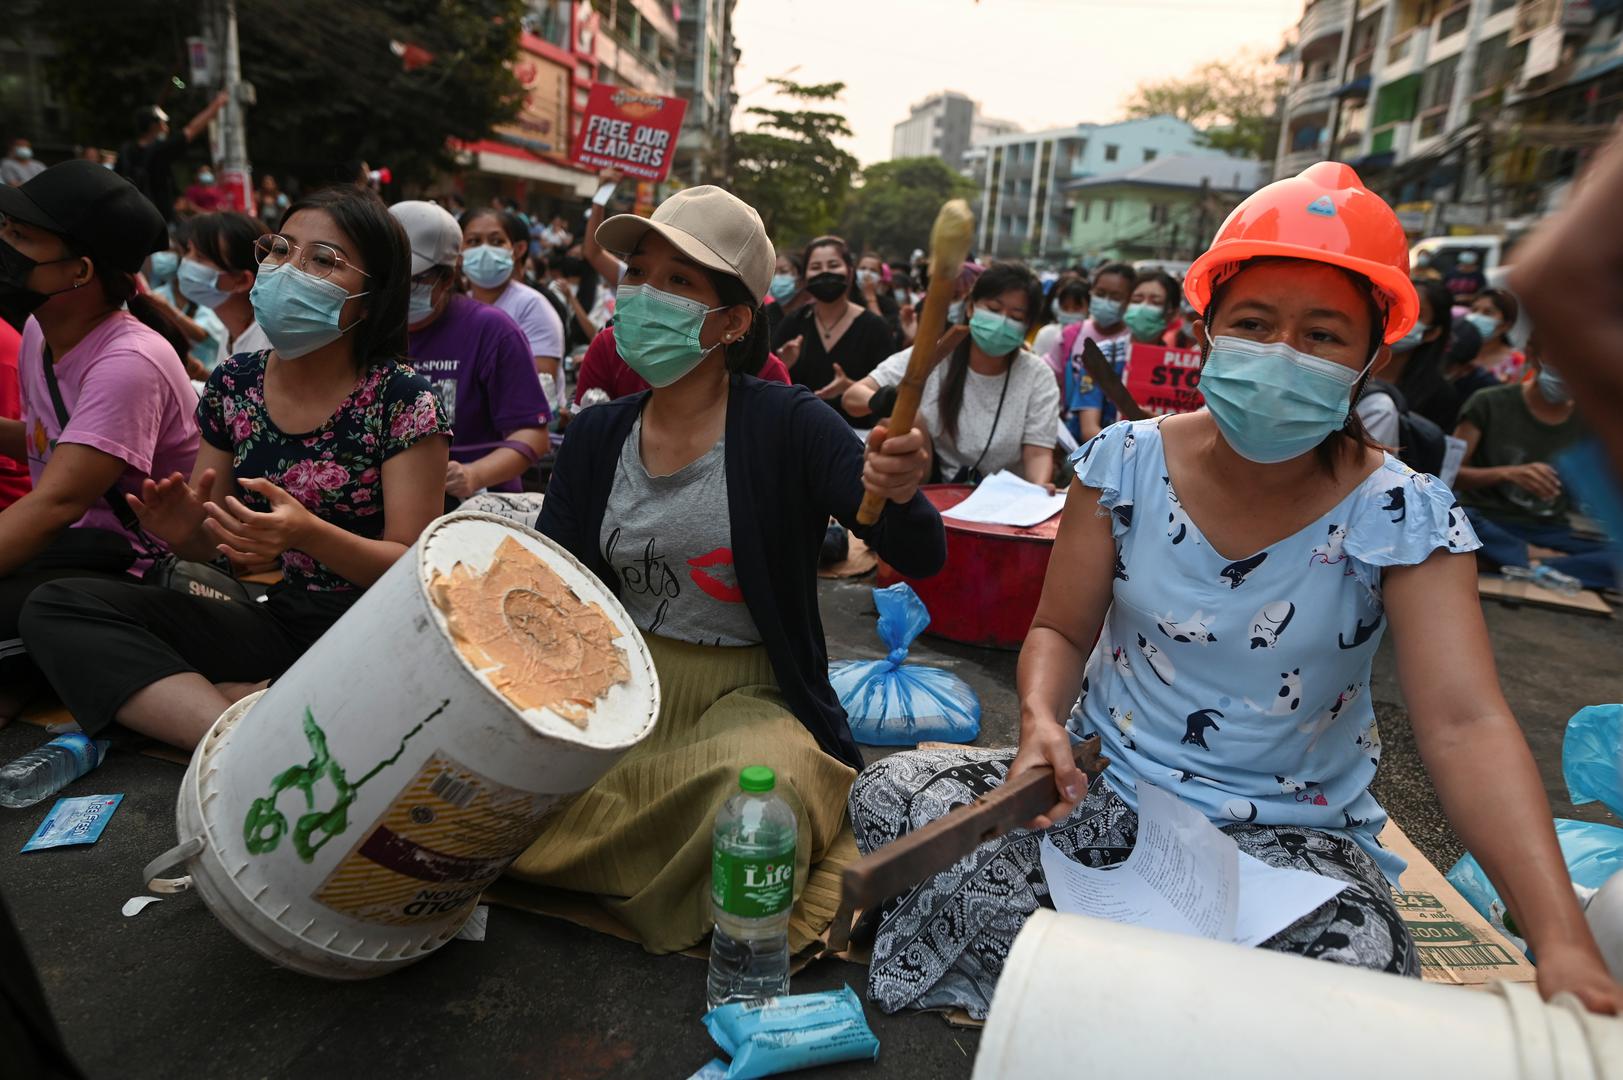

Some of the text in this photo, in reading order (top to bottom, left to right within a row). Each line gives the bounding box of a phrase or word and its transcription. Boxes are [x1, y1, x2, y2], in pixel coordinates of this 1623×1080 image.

[588, 115, 670, 149] FREE OUR
[583, 133, 664, 167] LEADERS
[1163, 351, 1201, 368] PLEA
[1151, 365, 1201, 388] STO
[743, 864, 792, 888] Life
